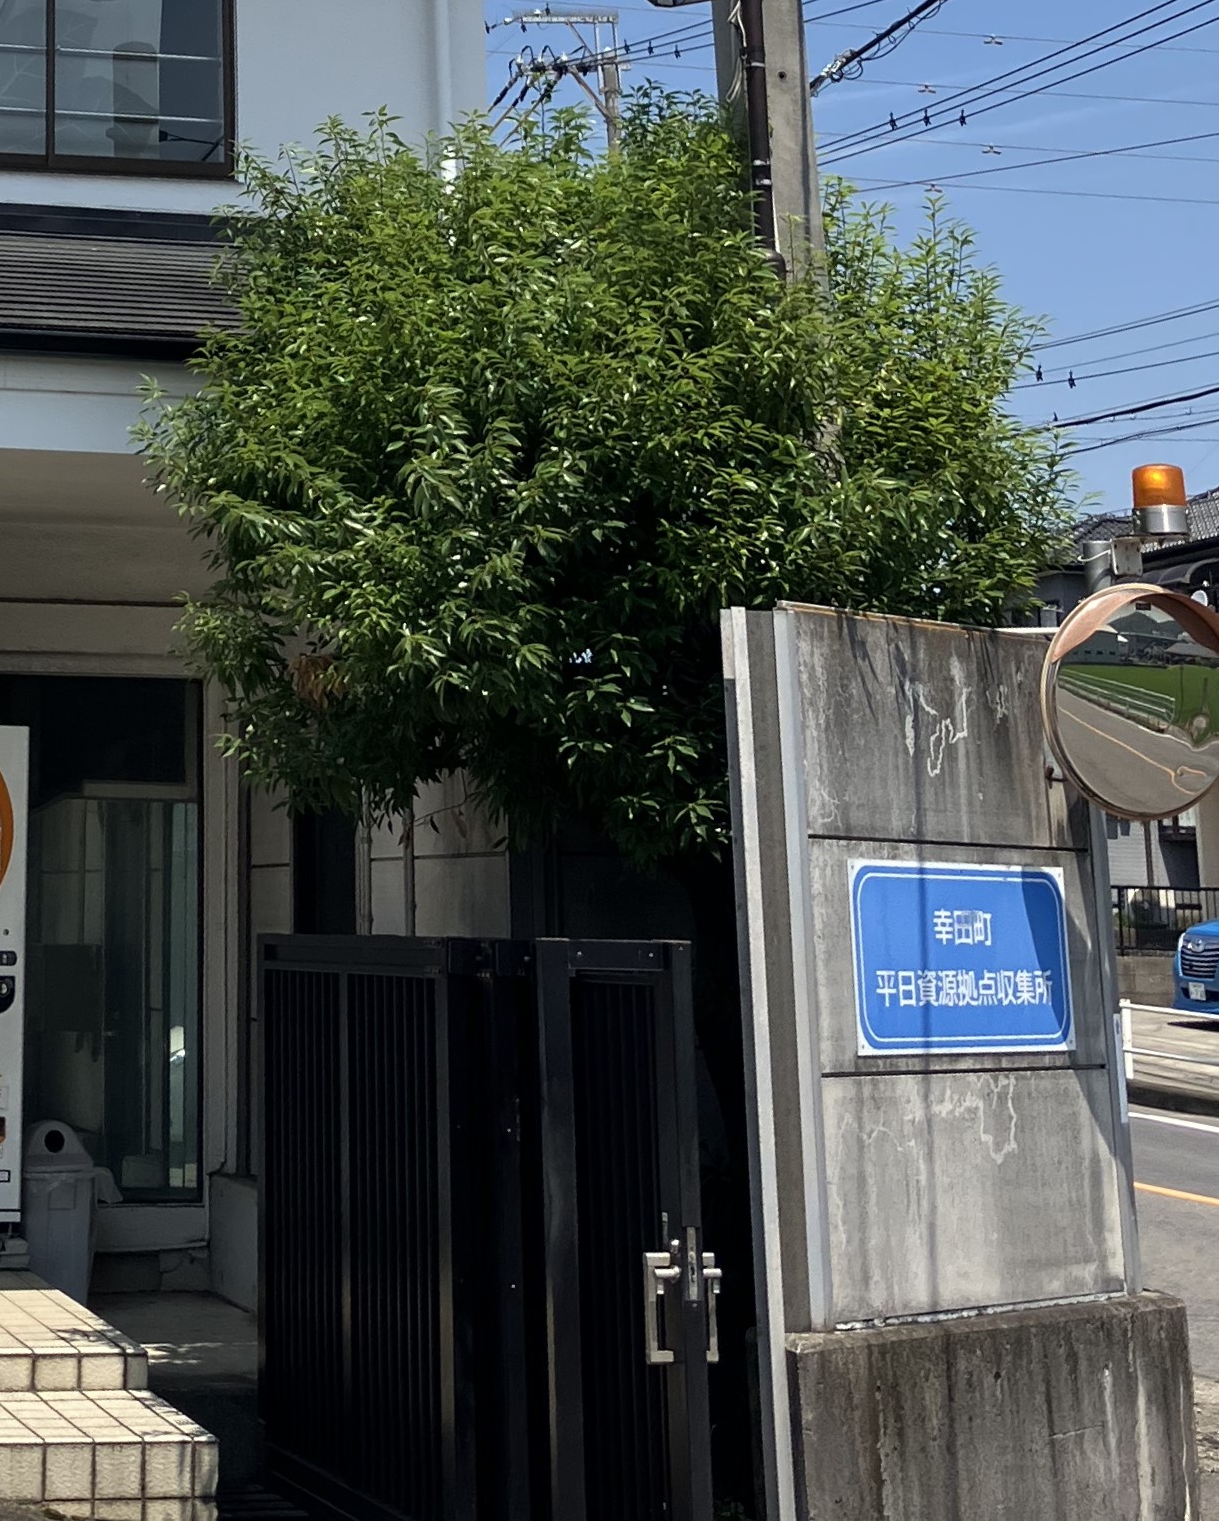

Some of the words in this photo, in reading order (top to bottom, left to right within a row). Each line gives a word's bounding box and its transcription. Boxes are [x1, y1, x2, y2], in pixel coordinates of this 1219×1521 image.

[933, 909, 993, 946] 幸田町
[876, 969, 1052, 1007] 平日資源拠点収集所
